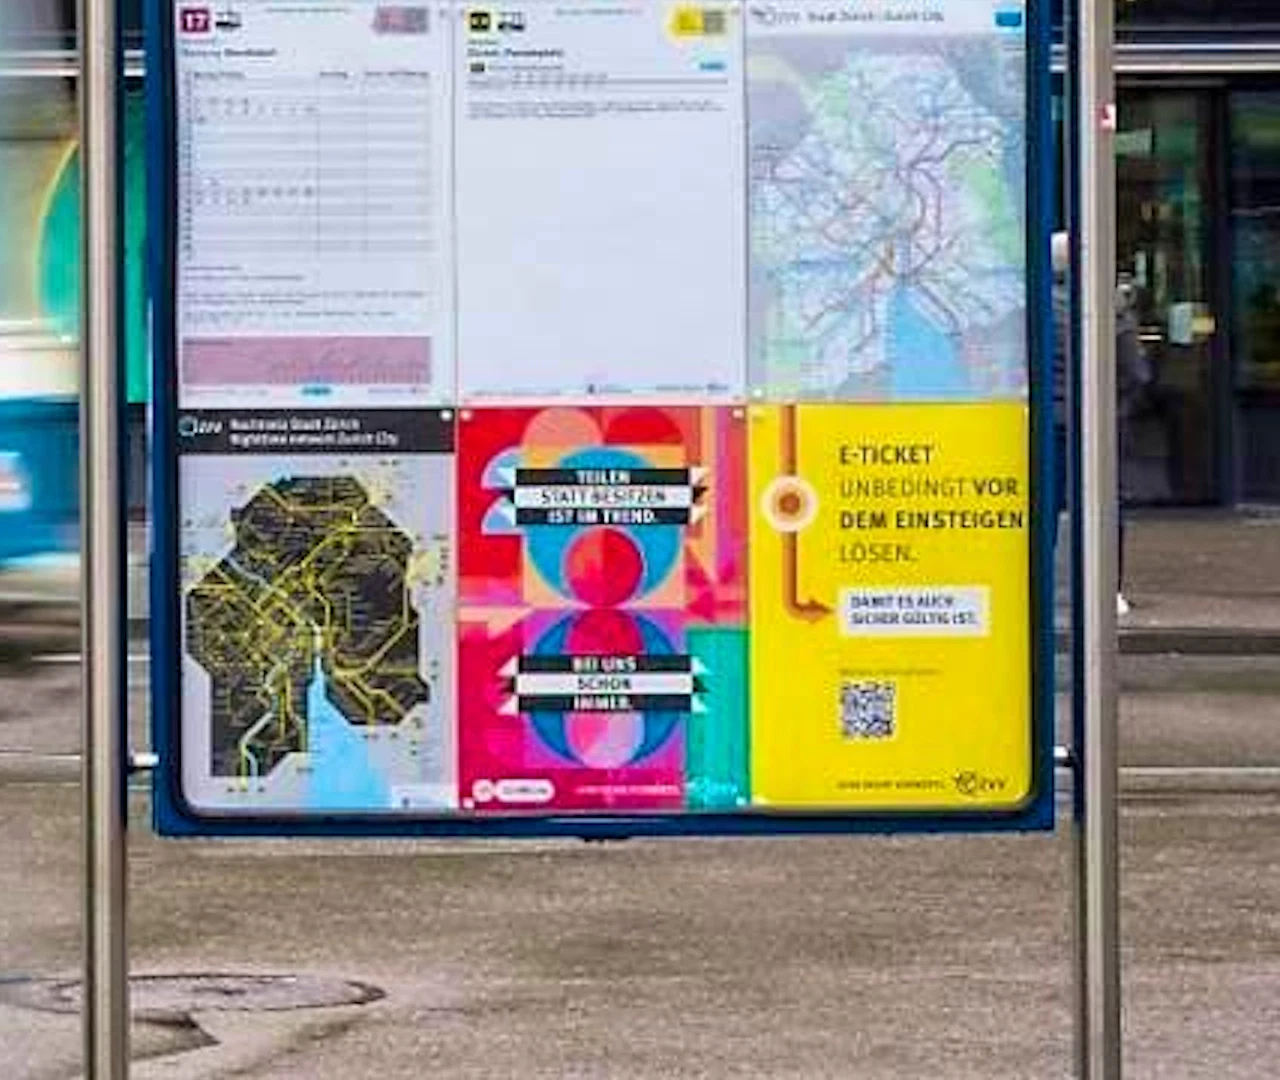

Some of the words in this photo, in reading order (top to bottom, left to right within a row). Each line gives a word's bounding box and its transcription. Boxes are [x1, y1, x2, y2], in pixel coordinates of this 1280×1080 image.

[840, 445, 934, 465] E-TICKET
[840, 479, 964, 498] UNBEDINGT
[973, 477, 1018, 497] VOR
[840, 510, 887, 529] DEM
[896, 510, 1023, 529] EINSTEIGEN
[840, 541, 917, 563] LÖSEN.
[577, 677, 631, 690] SCHON
